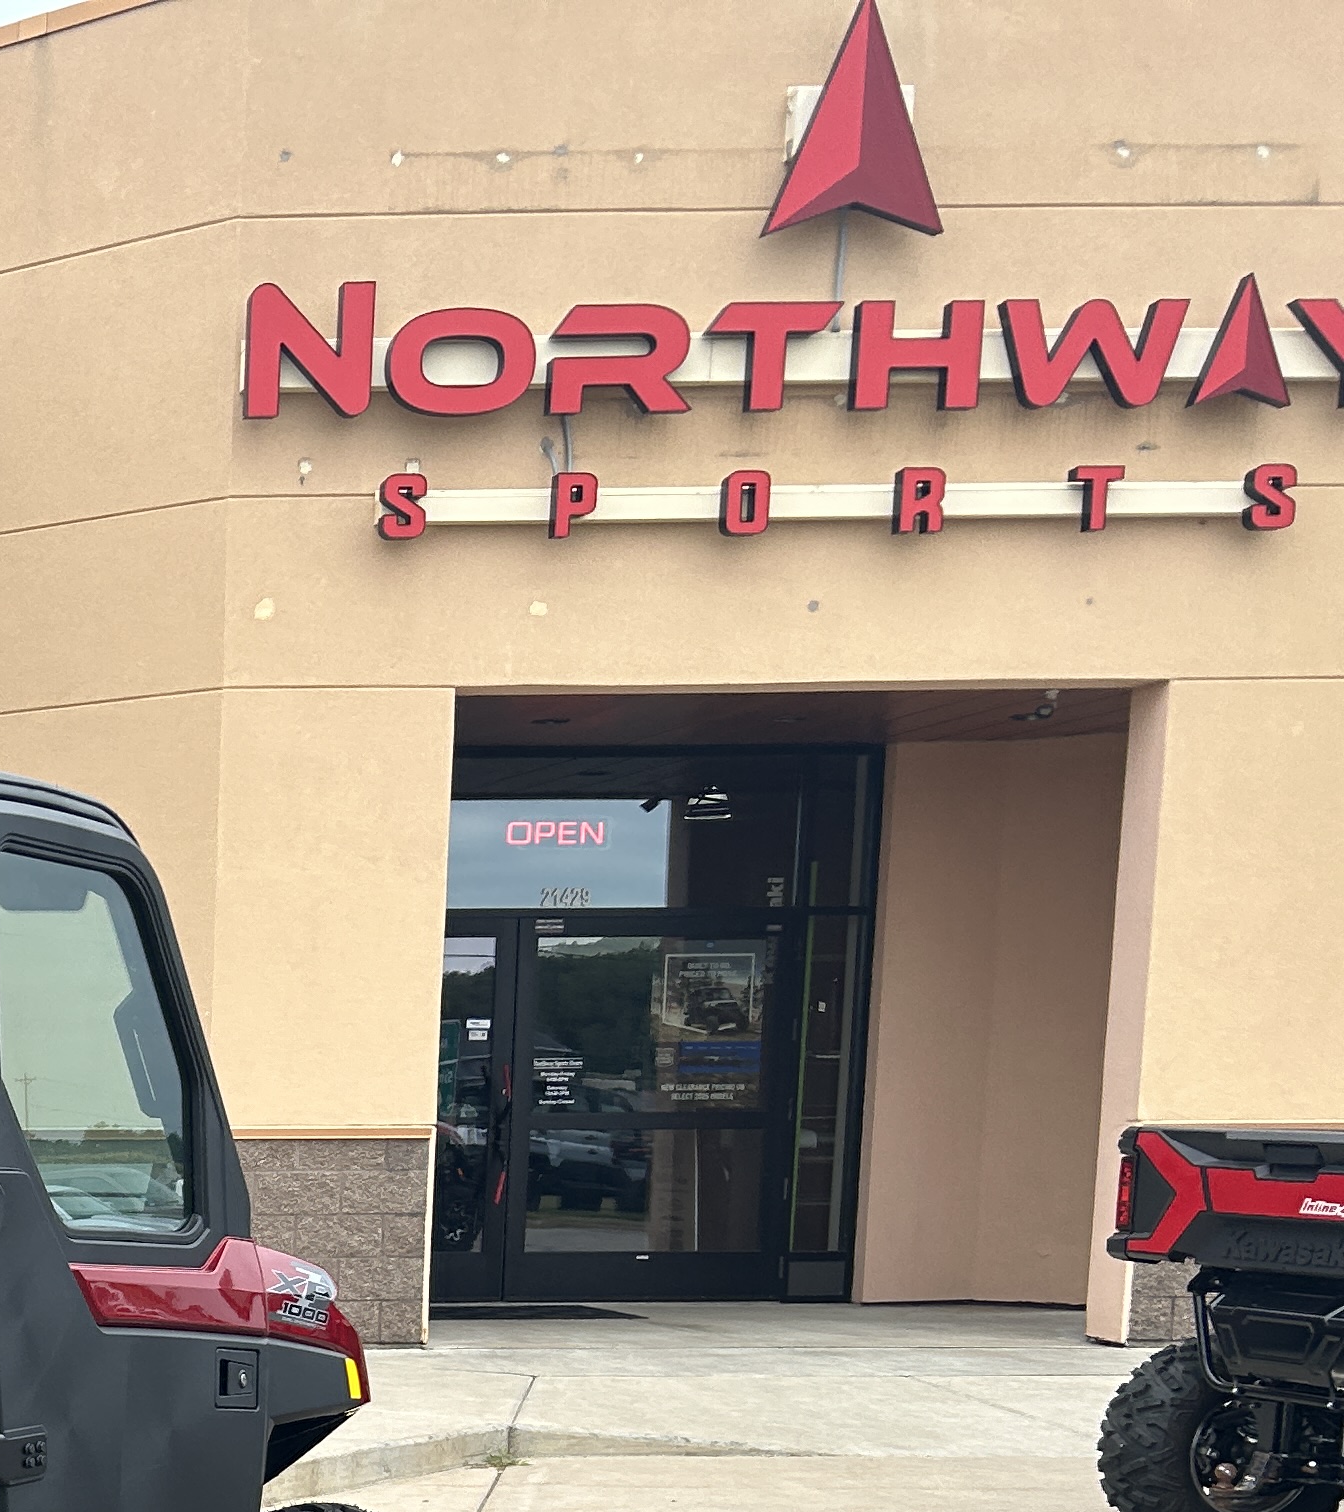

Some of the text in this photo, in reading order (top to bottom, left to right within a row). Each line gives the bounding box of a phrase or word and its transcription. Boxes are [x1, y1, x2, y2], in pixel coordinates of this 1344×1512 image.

[378, 463, 1297, 540] SPORTS
[506, 820, 605, 847] OPEN
[540, 887, 590, 907] 21429
[1303, 1200, 1338, 1213] Inline
[266, 1269, 333, 1303] XP
[282, 1302, 329, 1324] 1000
